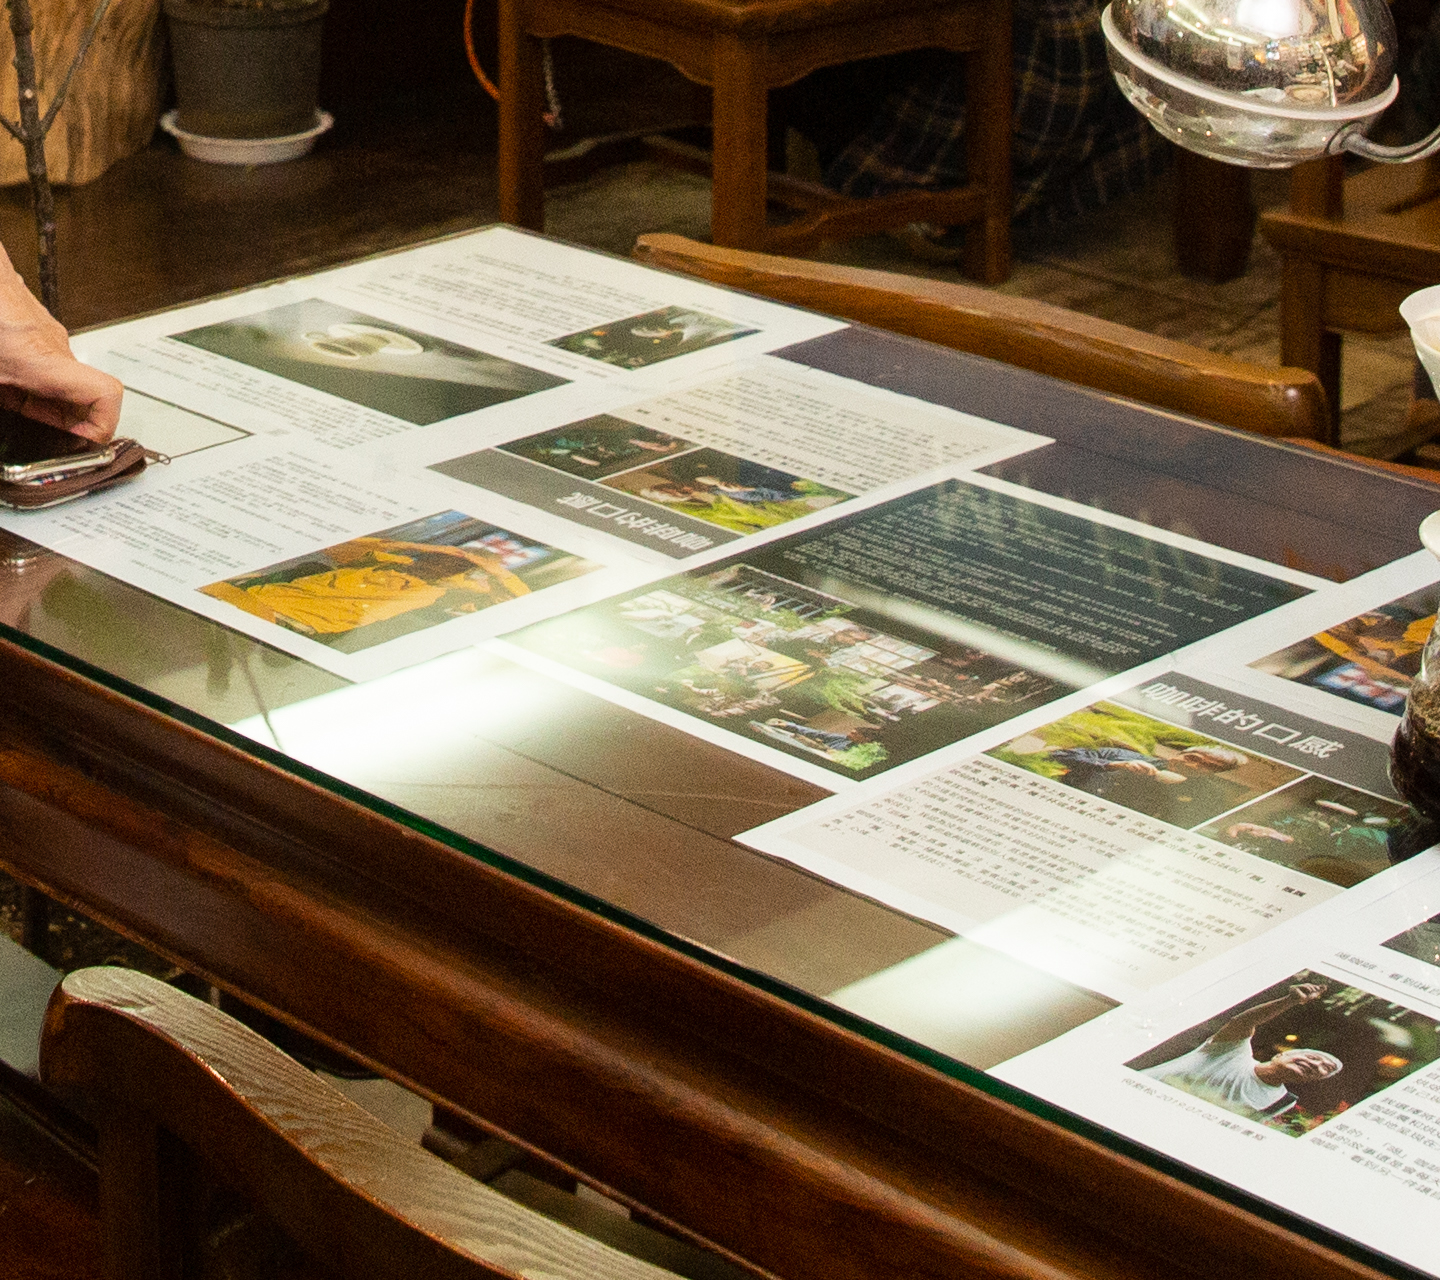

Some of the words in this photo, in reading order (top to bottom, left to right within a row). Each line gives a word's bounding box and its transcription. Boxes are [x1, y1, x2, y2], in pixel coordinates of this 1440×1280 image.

[1139, 678, 1347, 761] 咖啡的口感
